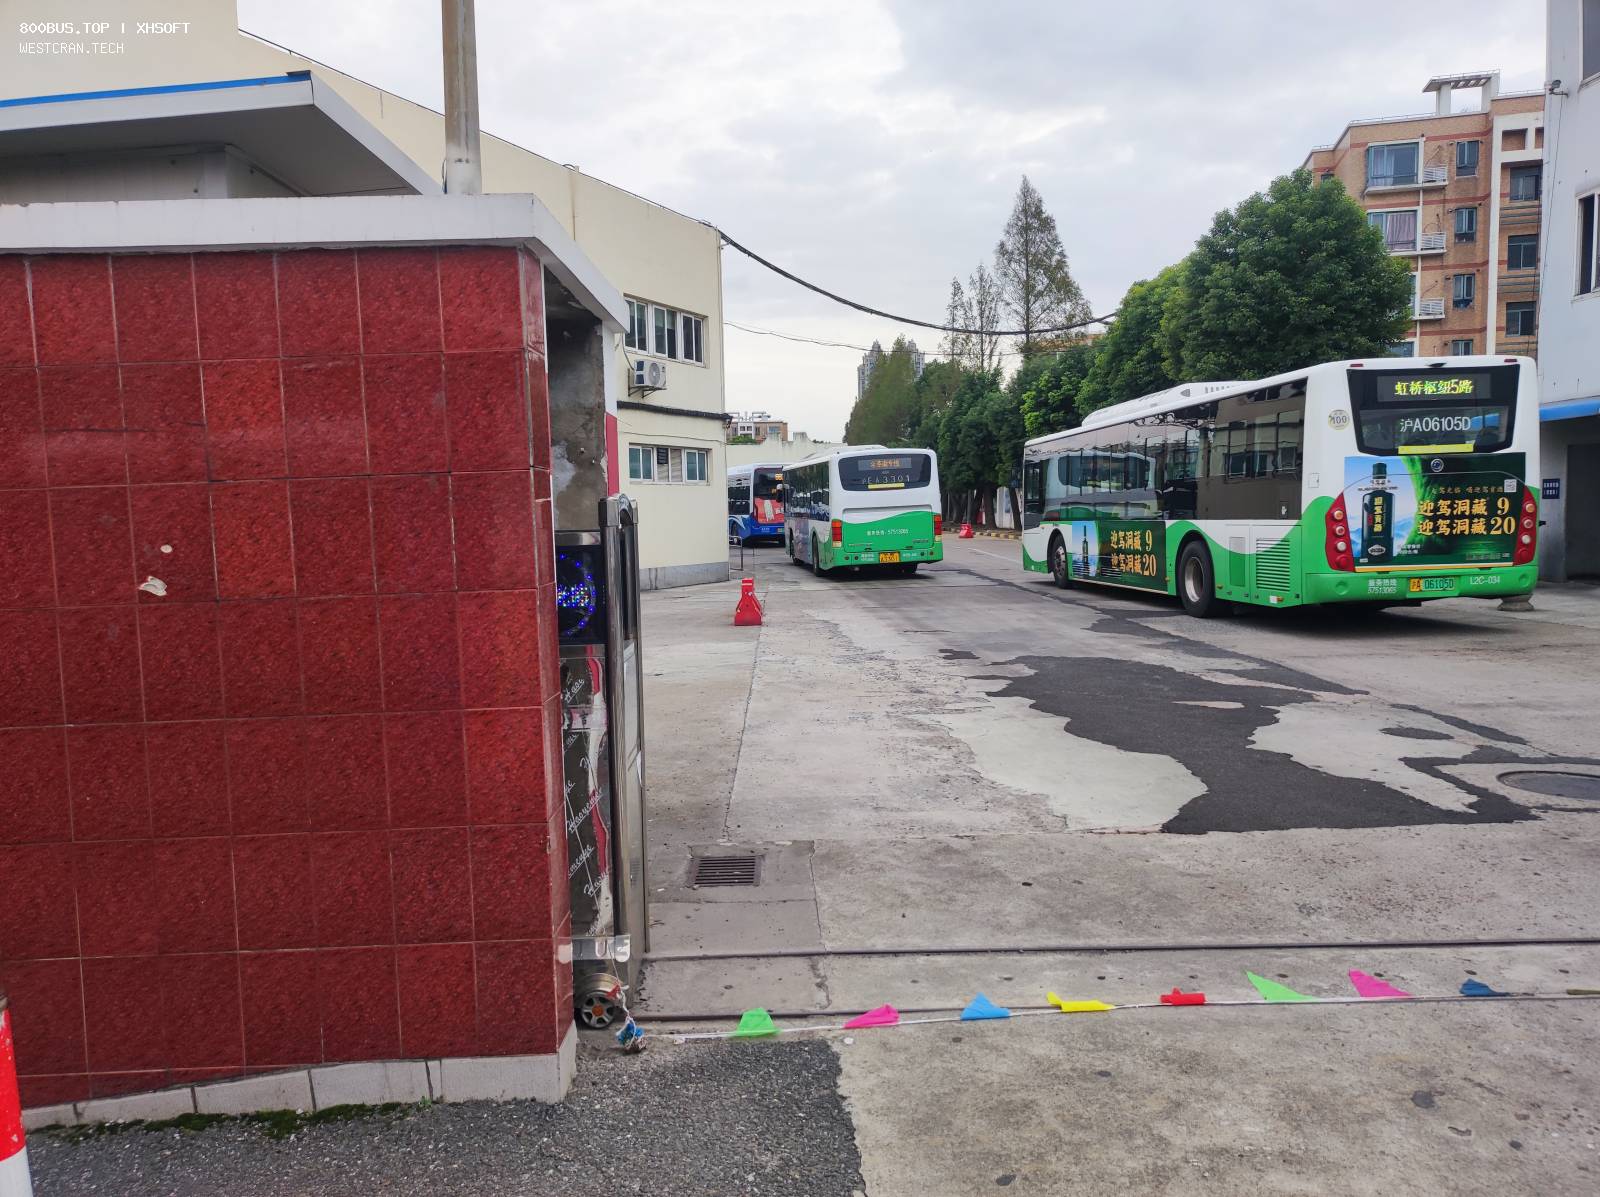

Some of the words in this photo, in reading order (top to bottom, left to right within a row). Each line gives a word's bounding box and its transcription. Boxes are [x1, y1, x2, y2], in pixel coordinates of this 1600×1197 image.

[1394, 379, 1474, 396] 虹桥枢纽5路
[1400, 416, 1471, 433] 沪A06105D
[1418, 498, 1488, 517] 迎驾洞藏
[1497, 497, 1510, 516] 9
[1418, 518, 1488, 536] 迎驾洞藏
[1490, 516, 1516, 536] 20
[1145, 529, 1152, 551] 9
[1143, 553, 1157, 577] 20
